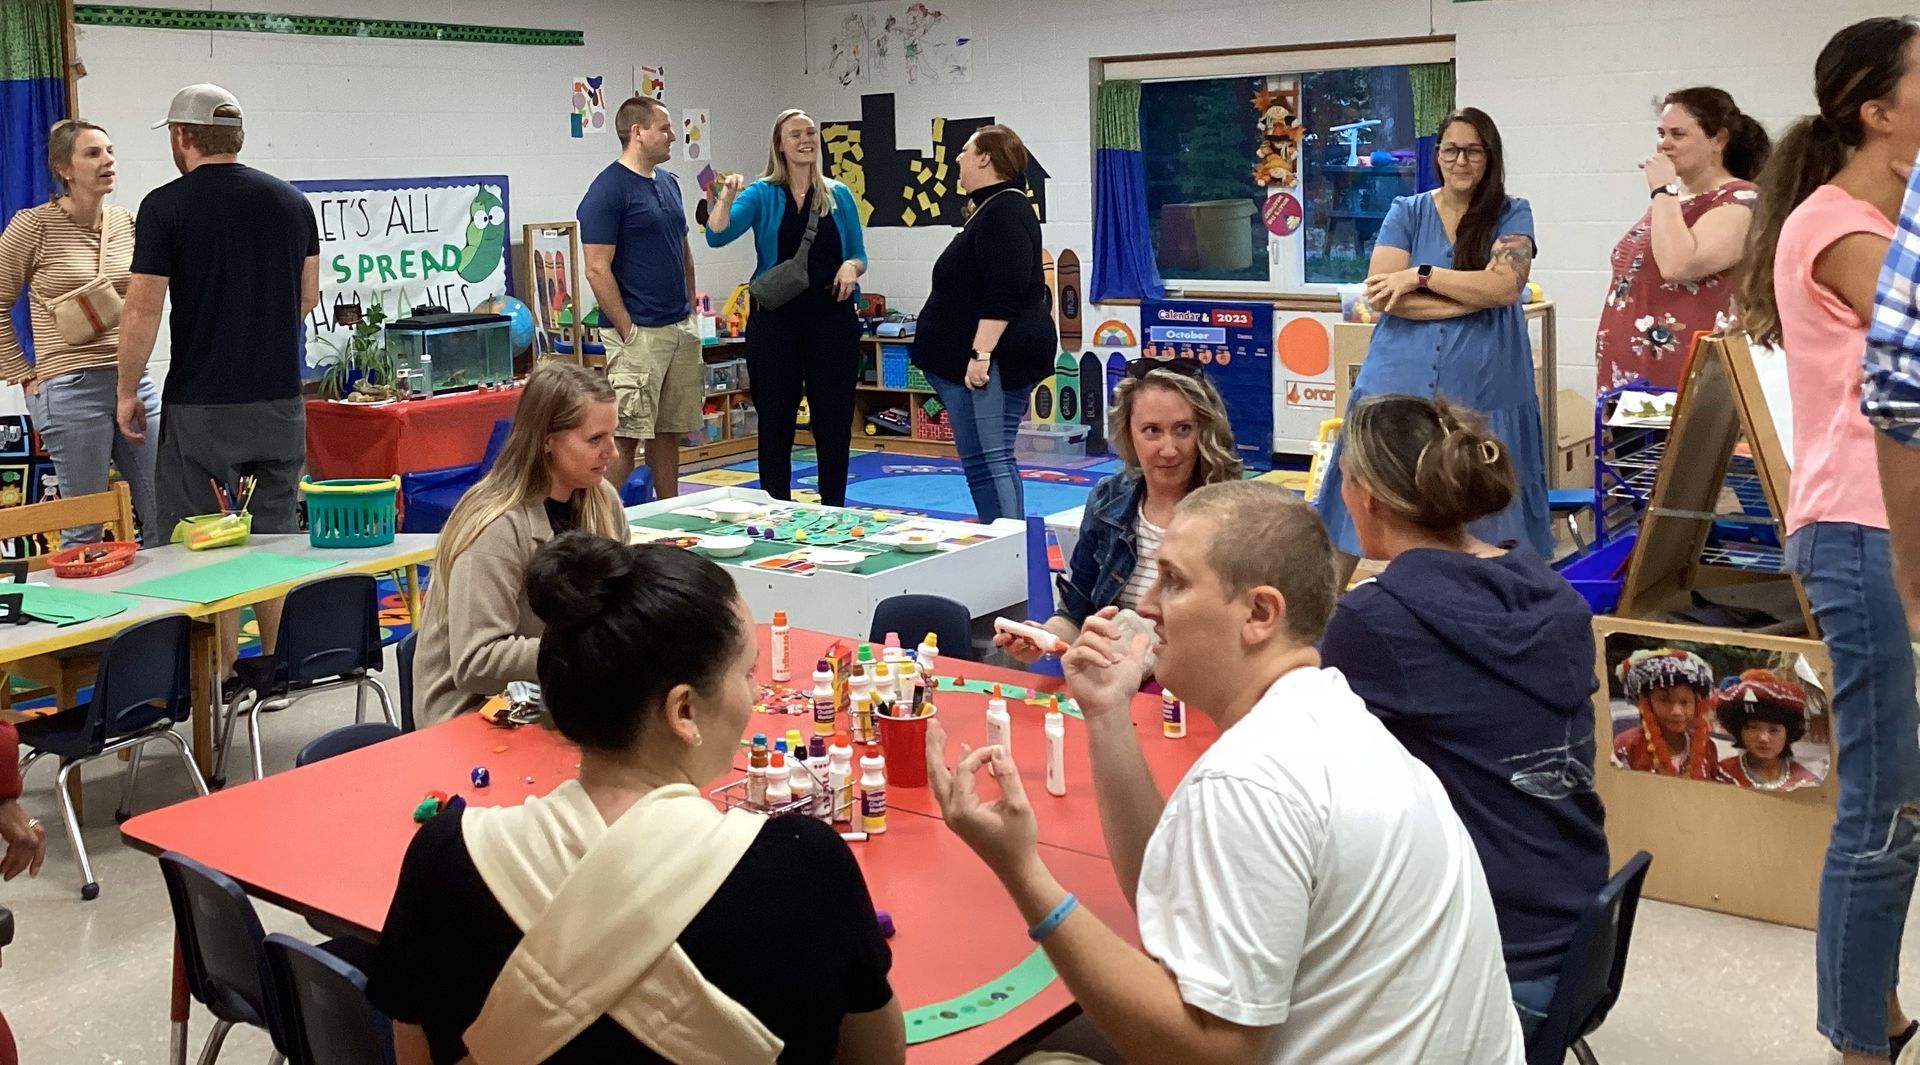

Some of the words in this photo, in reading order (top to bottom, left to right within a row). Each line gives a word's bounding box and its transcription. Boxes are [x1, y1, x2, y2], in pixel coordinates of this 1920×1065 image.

[386, 194, 439, 236] ALL
[332, 244, 462, 283] SPREAD
[1158, 309, 1201, 322] Calendar
[1202, 312, 1210, 323] &
[1217, 313, 1249, 324] 2023
[1166, 329, 1210, 340] October
[1062, 391, 1071, 416] GREEN
[1086, 392, 1096, 418] BLACK
